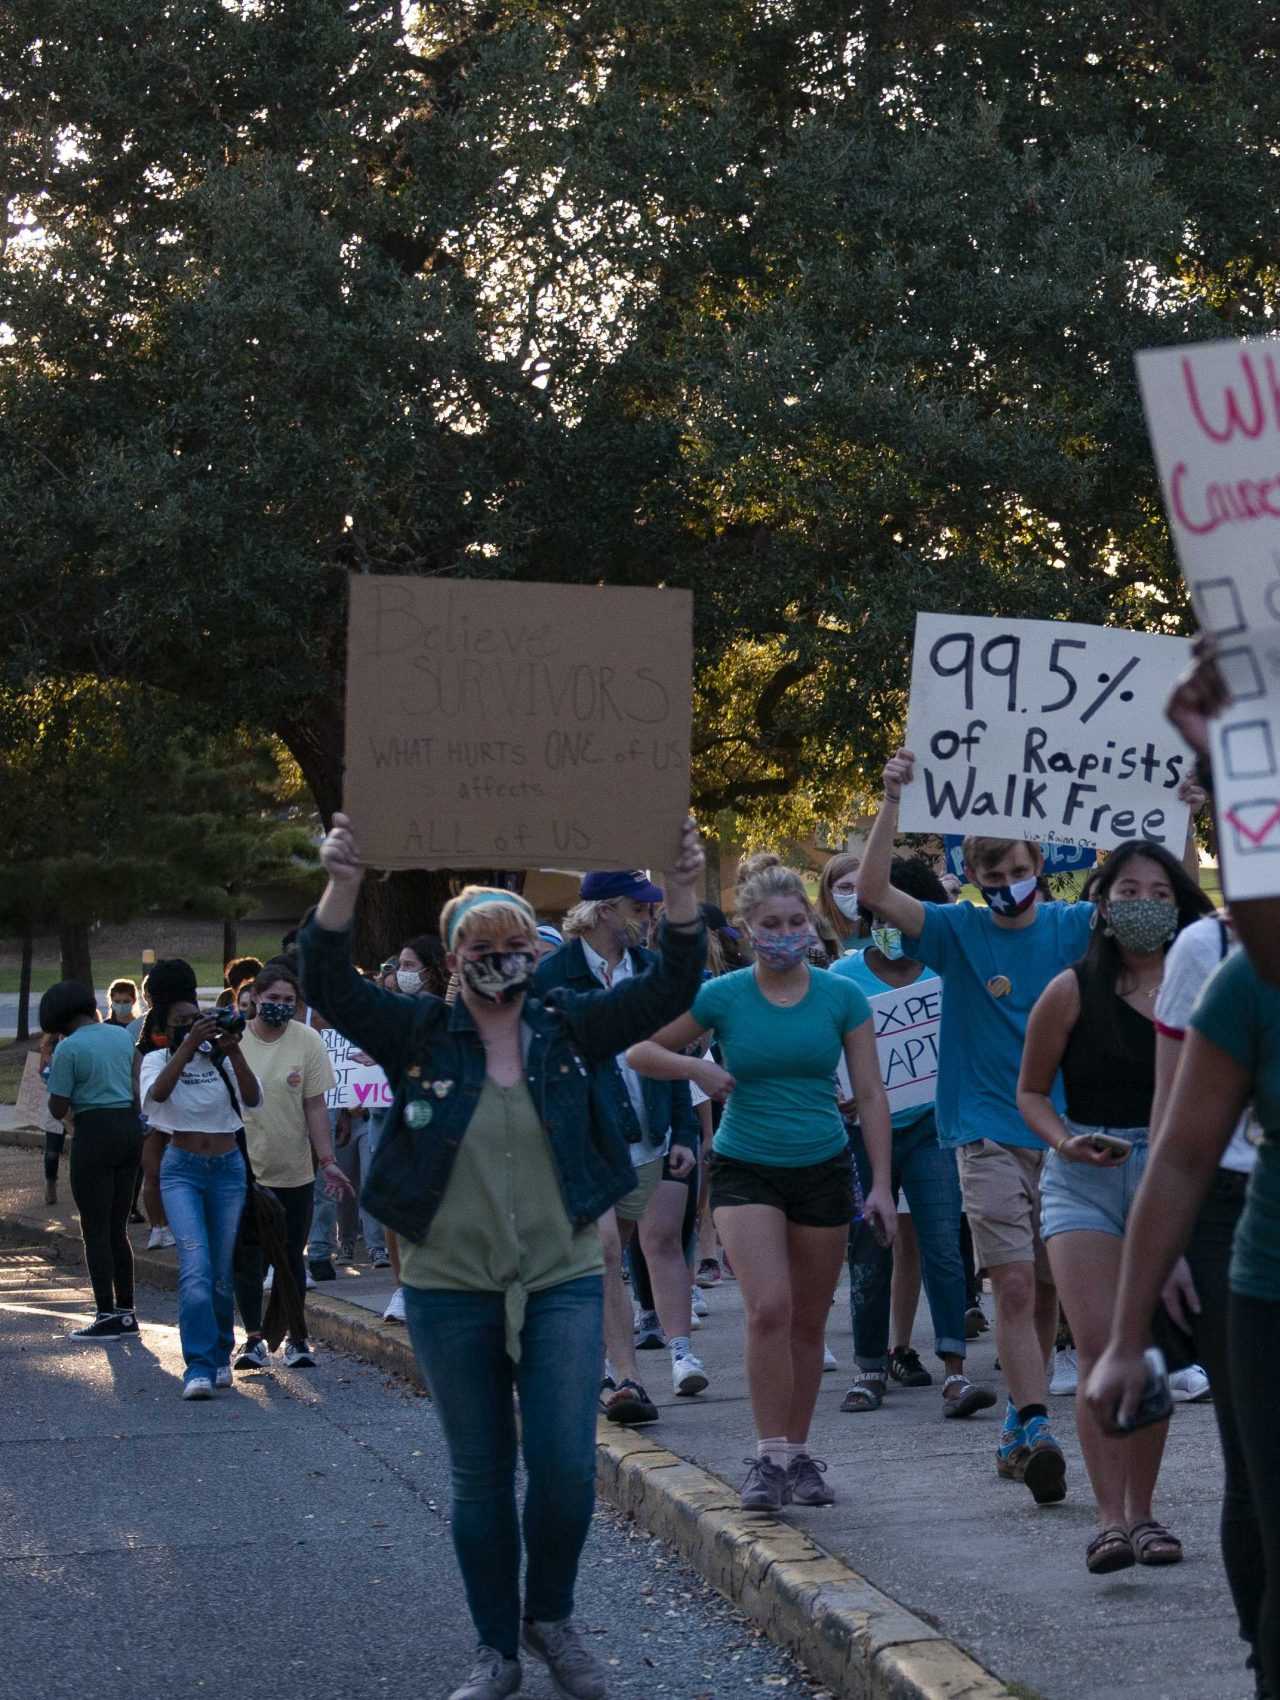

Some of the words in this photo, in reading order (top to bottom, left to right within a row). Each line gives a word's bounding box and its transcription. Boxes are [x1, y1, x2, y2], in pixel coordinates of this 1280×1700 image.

[364, 584, 562, 658] Believe
[402, 656, 670, 724] SURVIVORS
[929, 632, 1141, 723] 99.5%
[370, 736, 433, 768] WHAT
[448, 740, 528, 767] HURTS
[545, 730, 600, 770] ONE
[615, 740, 646, 763] of
[653, 740, 686, 770] US
[930, 720, 988, 762] of
[1023, 727, 1184, 789] Rapists
[404, 820, 473, 854] ALL
[494, 824, 534, 852] of
[553, 819, 592, 852] US
[923, 765, 1048, 820] Walk
[1062, 782, 1166, 843] Free
